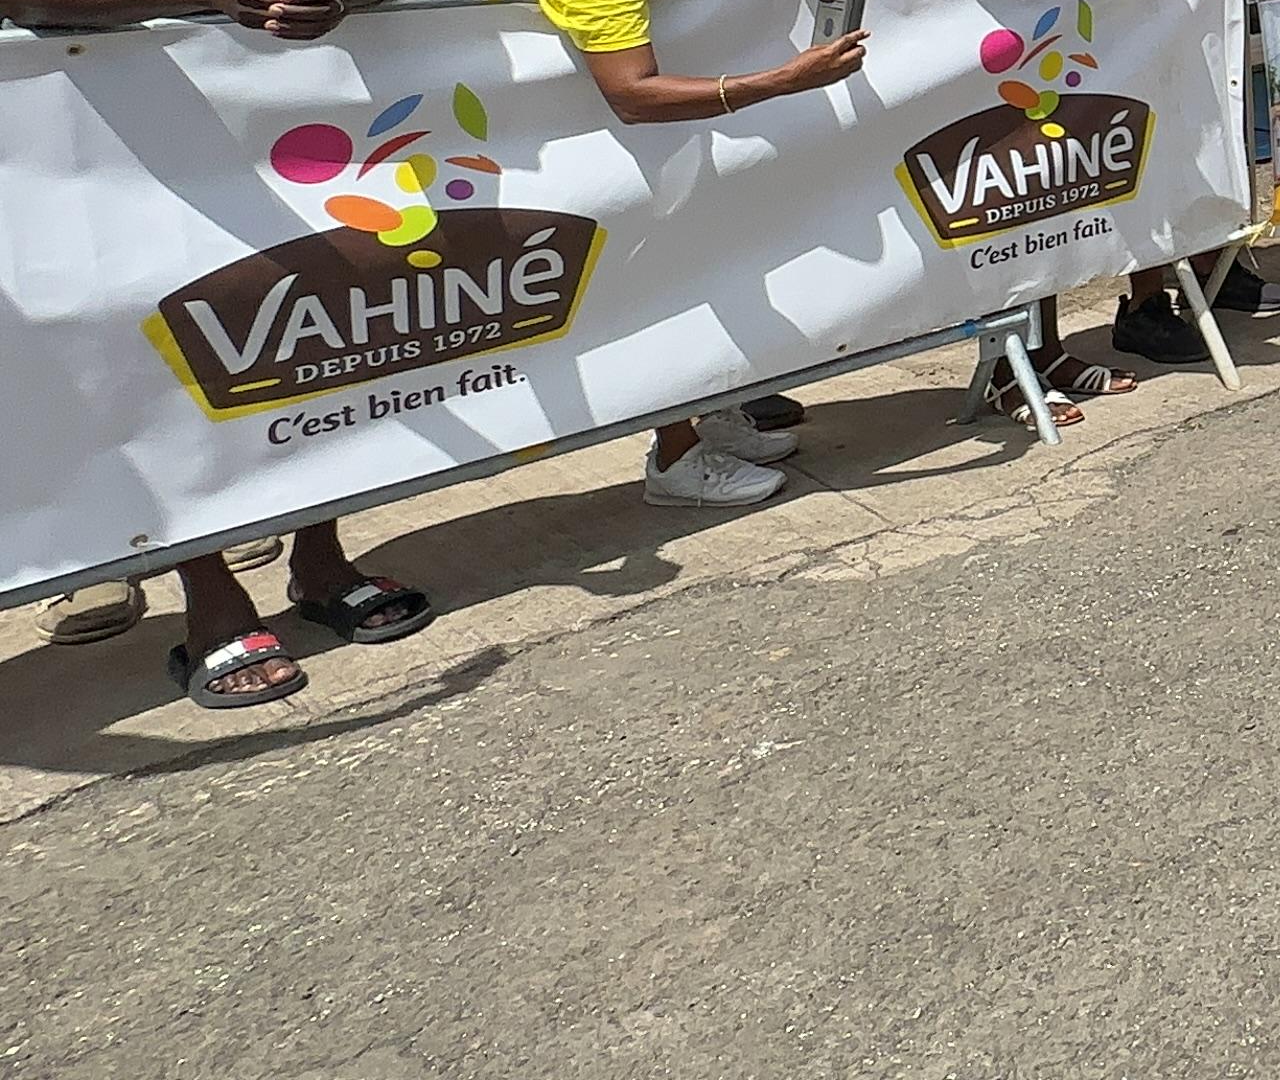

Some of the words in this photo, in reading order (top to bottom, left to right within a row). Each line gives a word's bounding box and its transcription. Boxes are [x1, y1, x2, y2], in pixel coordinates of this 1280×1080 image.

[986, 193, 1057, 224] DEPUIS
[1061, 182, 1100, 209] 1972
[969, 242, 1019, 270] C'est
[1023, 227, 1069, 257] bien
[1073, 216, 1114, 244] fait.
[294, 338, 421, 384] DEPUIS
[433, 321, 503, 354] 1972
[267, 407, 356, 446] C'est
[366, 380, 447, 419] bien
[456, 361, 528, 396] fait.
